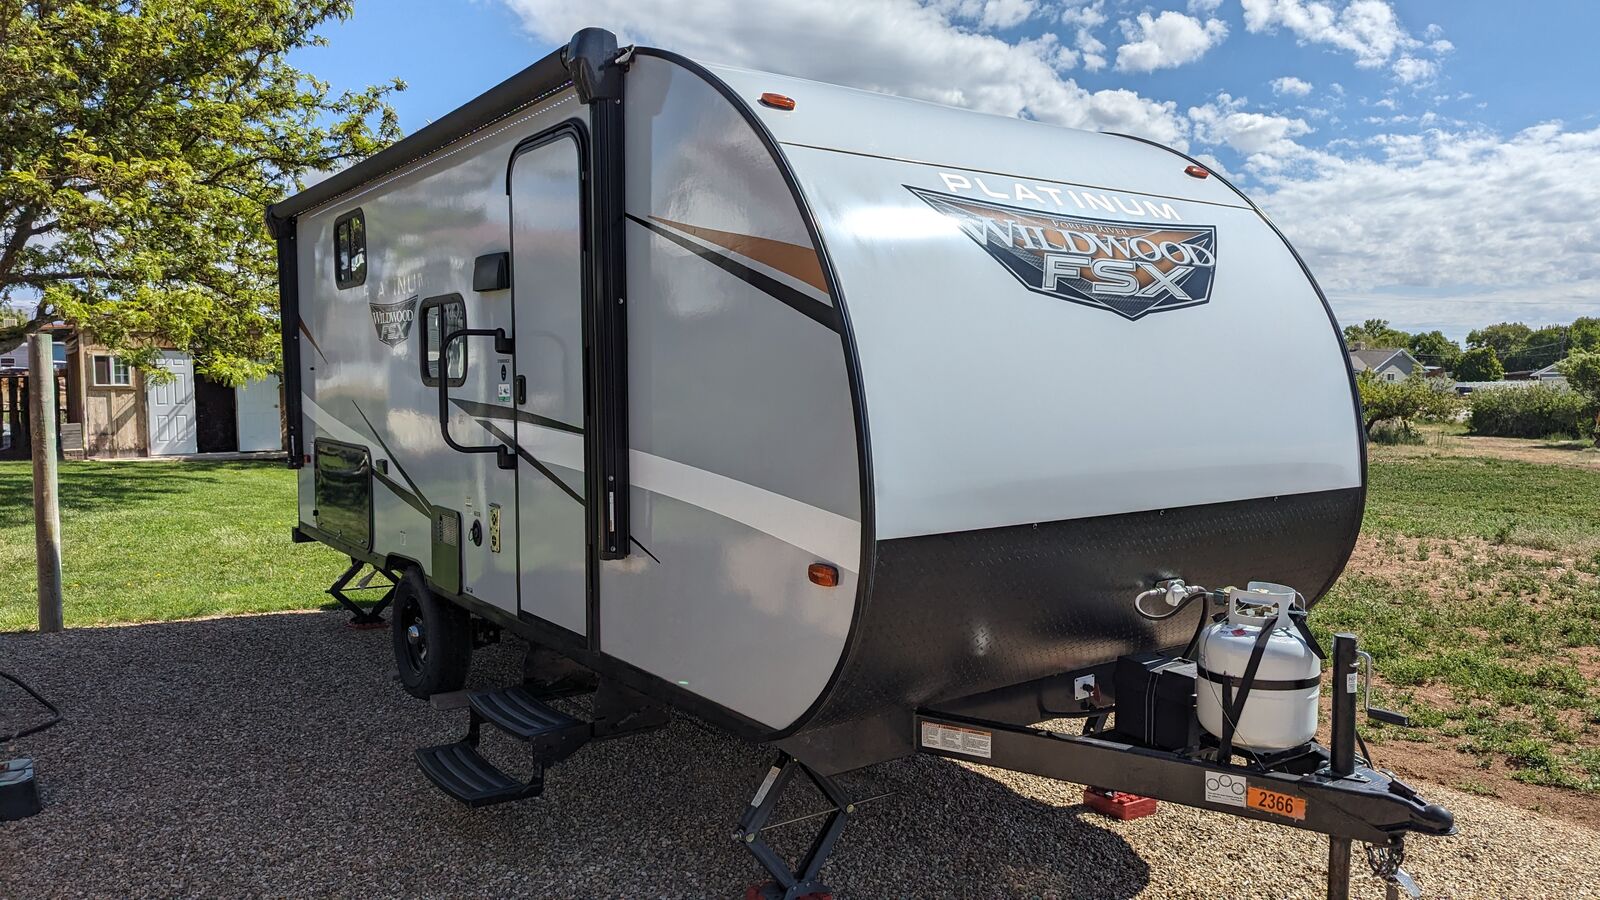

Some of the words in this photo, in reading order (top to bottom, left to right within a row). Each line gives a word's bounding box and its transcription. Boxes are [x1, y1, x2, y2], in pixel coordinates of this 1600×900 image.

[938, 172, 1183, 222] PLATINUM
[1096, 224, 1130, 236] RIVER
[964, 217, 1215, 267] WILDWOOD
[1042, 253, 1193, 301] FSX
[372, 310, 414, 324] WILDWOOD
[381, 321, 409, 340] FSX
[1258, 791, 1294, 814] 2366
